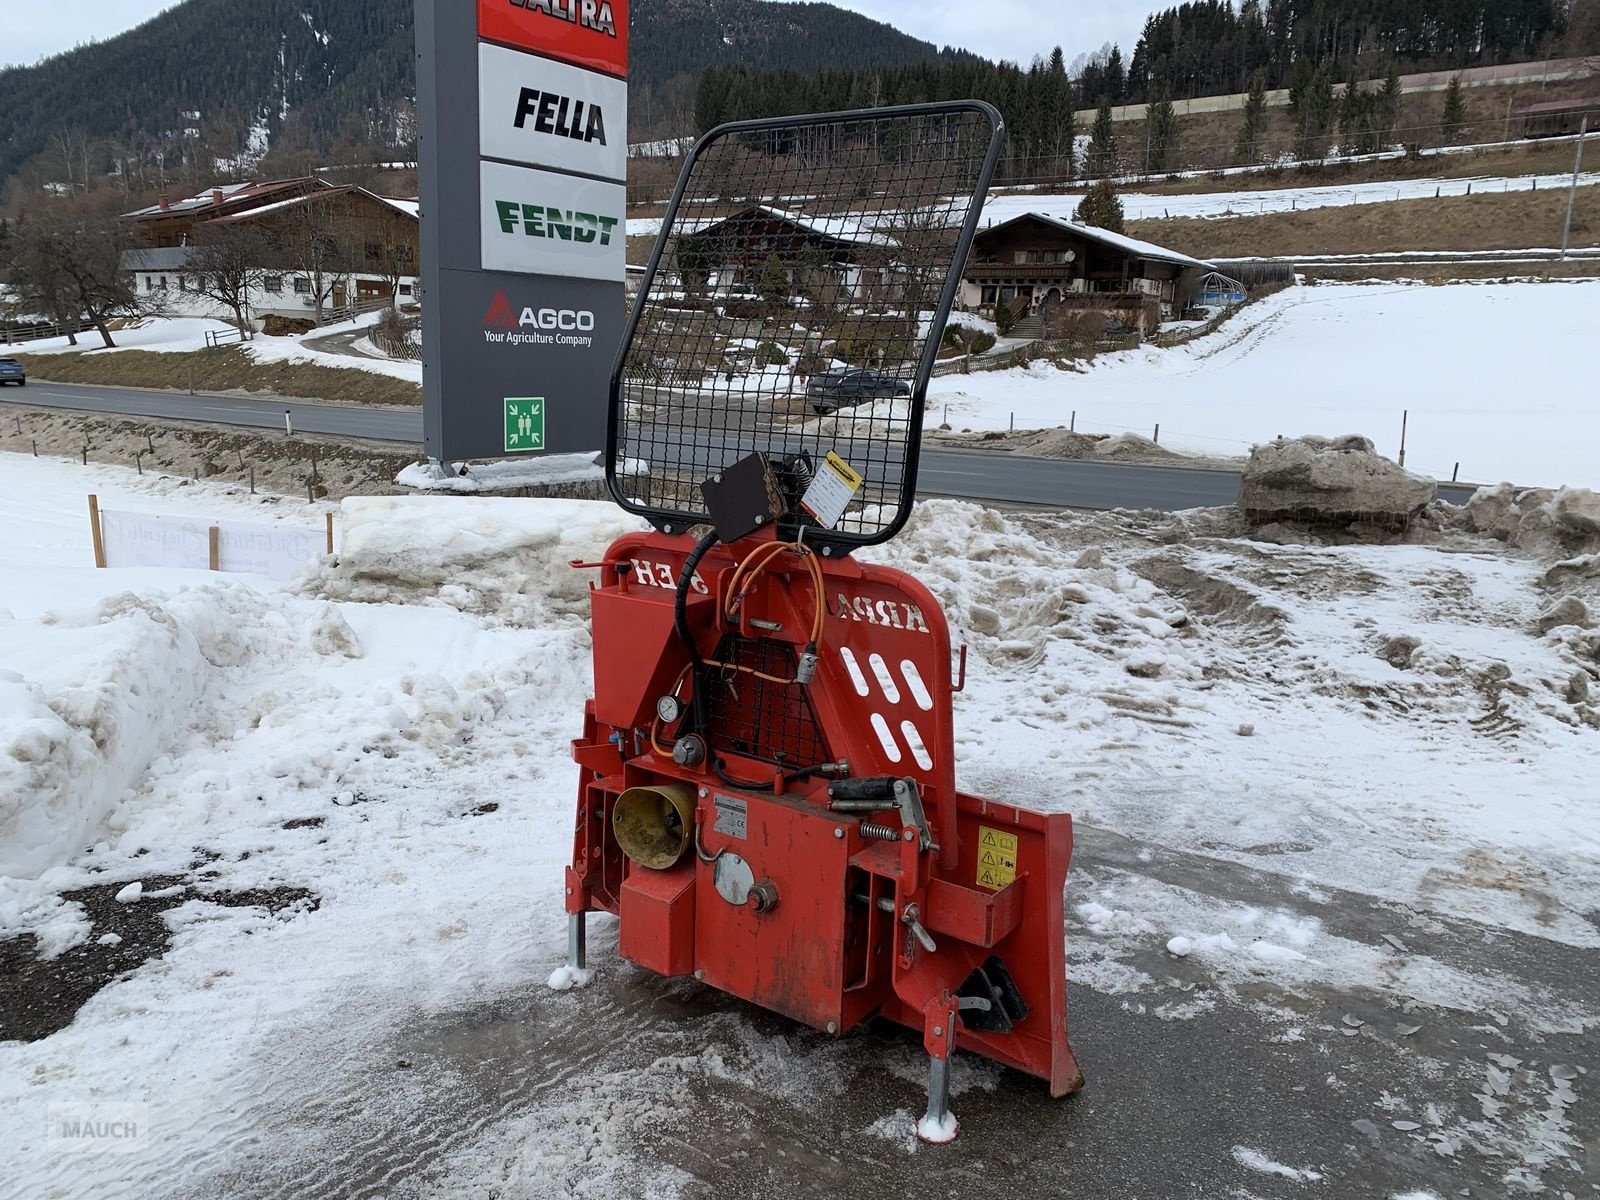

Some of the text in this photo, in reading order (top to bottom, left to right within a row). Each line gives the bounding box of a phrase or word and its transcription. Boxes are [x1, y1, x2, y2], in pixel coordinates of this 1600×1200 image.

[513, 86, 607, 146] FELLA
[495, 199, 618, 246] FENDT
[518, 307, 595, 331] AGCO
[484, 330, 592, 347] Your Agriculture Company
